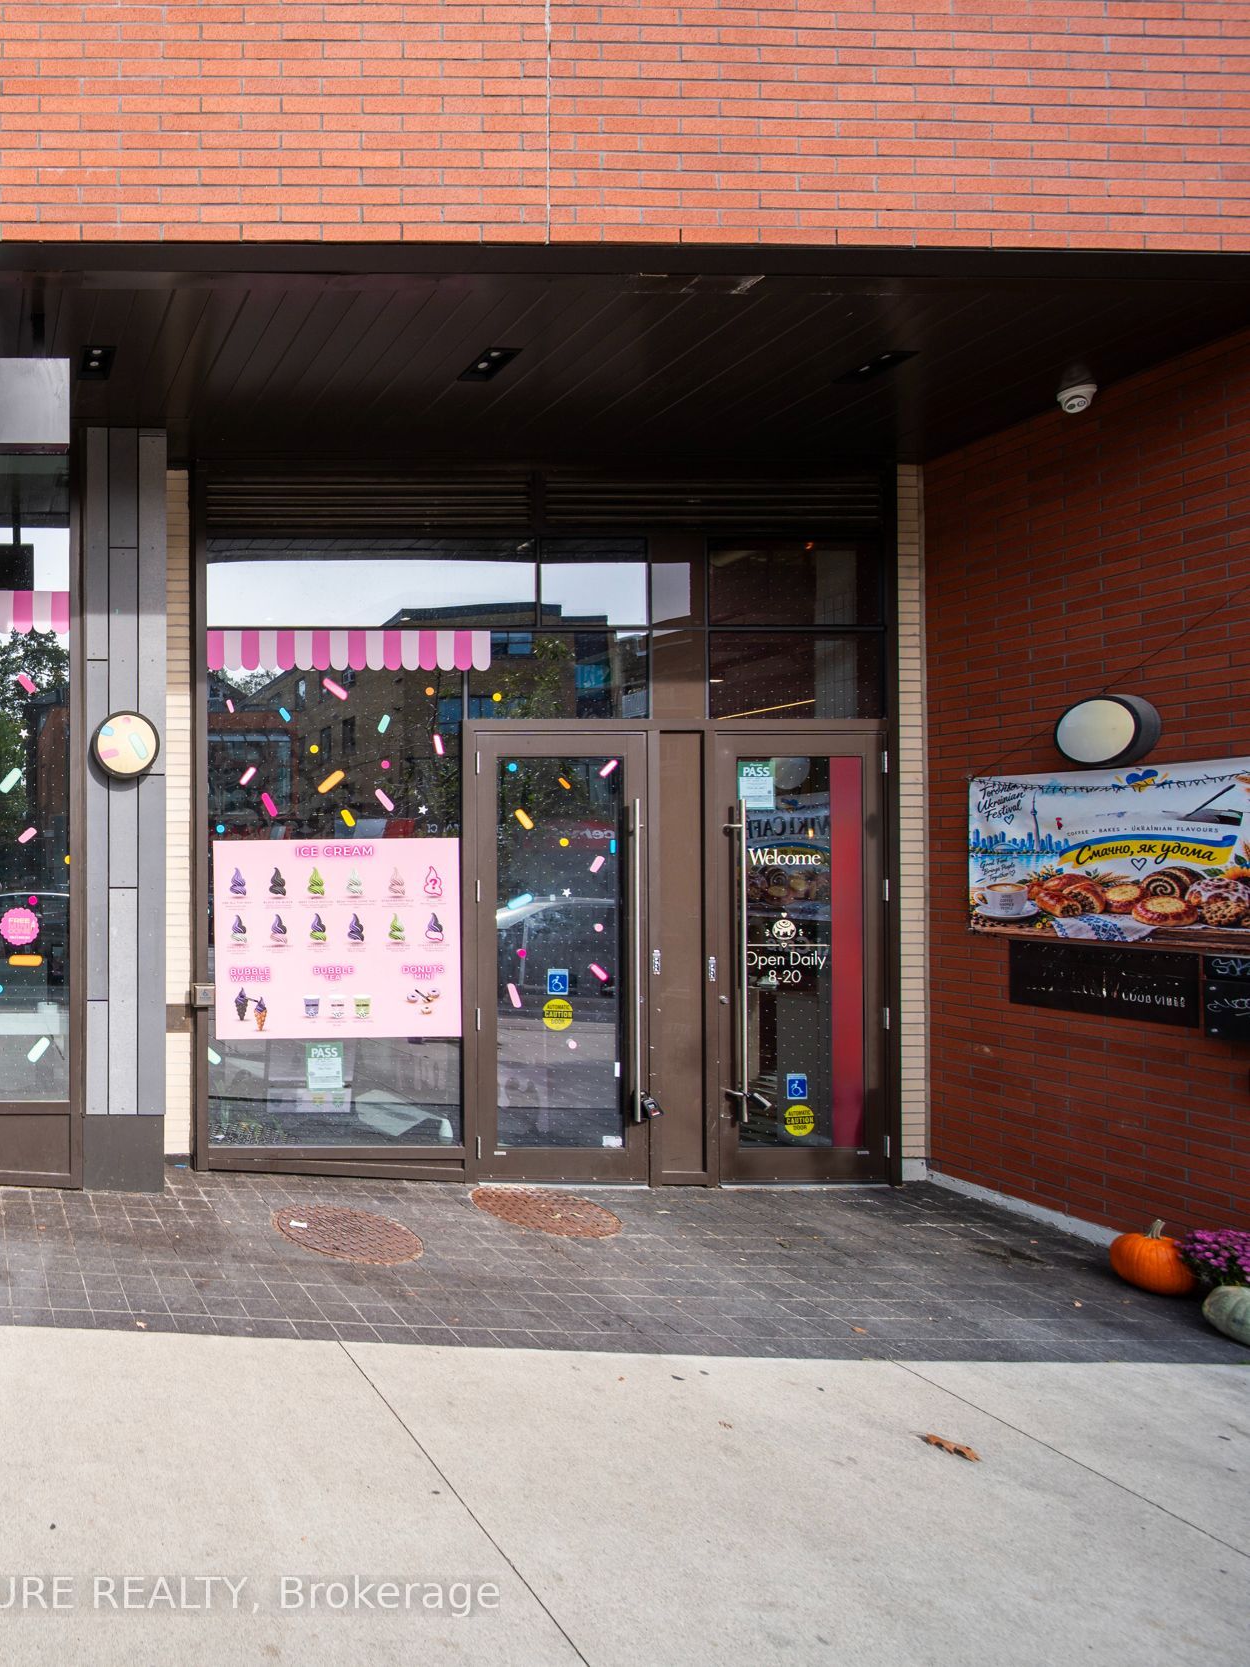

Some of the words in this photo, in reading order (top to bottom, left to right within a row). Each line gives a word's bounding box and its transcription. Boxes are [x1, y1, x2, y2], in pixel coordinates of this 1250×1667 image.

[743, 767, 770, 777] PASS
[984, 800, 1022, 822] Festival
[295, 846, 319, 857] ICE
[323, 845, 374, 857] CREAM
[1075, 844, 1134, 866] Смачно,
[1136, 843, 1157, 854] як
[1154, 842, 1217, 865] удома
[747, 848, 822, 866] Welcome
[747, 951, 785, 970] Open
[790, 950, 827, 970] Daily
[230, 967, 271, 976] BUBBLE
[312, 966, 354, 975] BUBBLE
[402, 965, 445, 974] DONUTS
[230, 975, 271, 983] WAFFLES
[768, 969, 802, 983] 8-20
[544, 1010, 573, 1018] CAUTION
[311, 1047, 338, 1058] PASS
[786, 1116, 814, 1124] CAUTION
